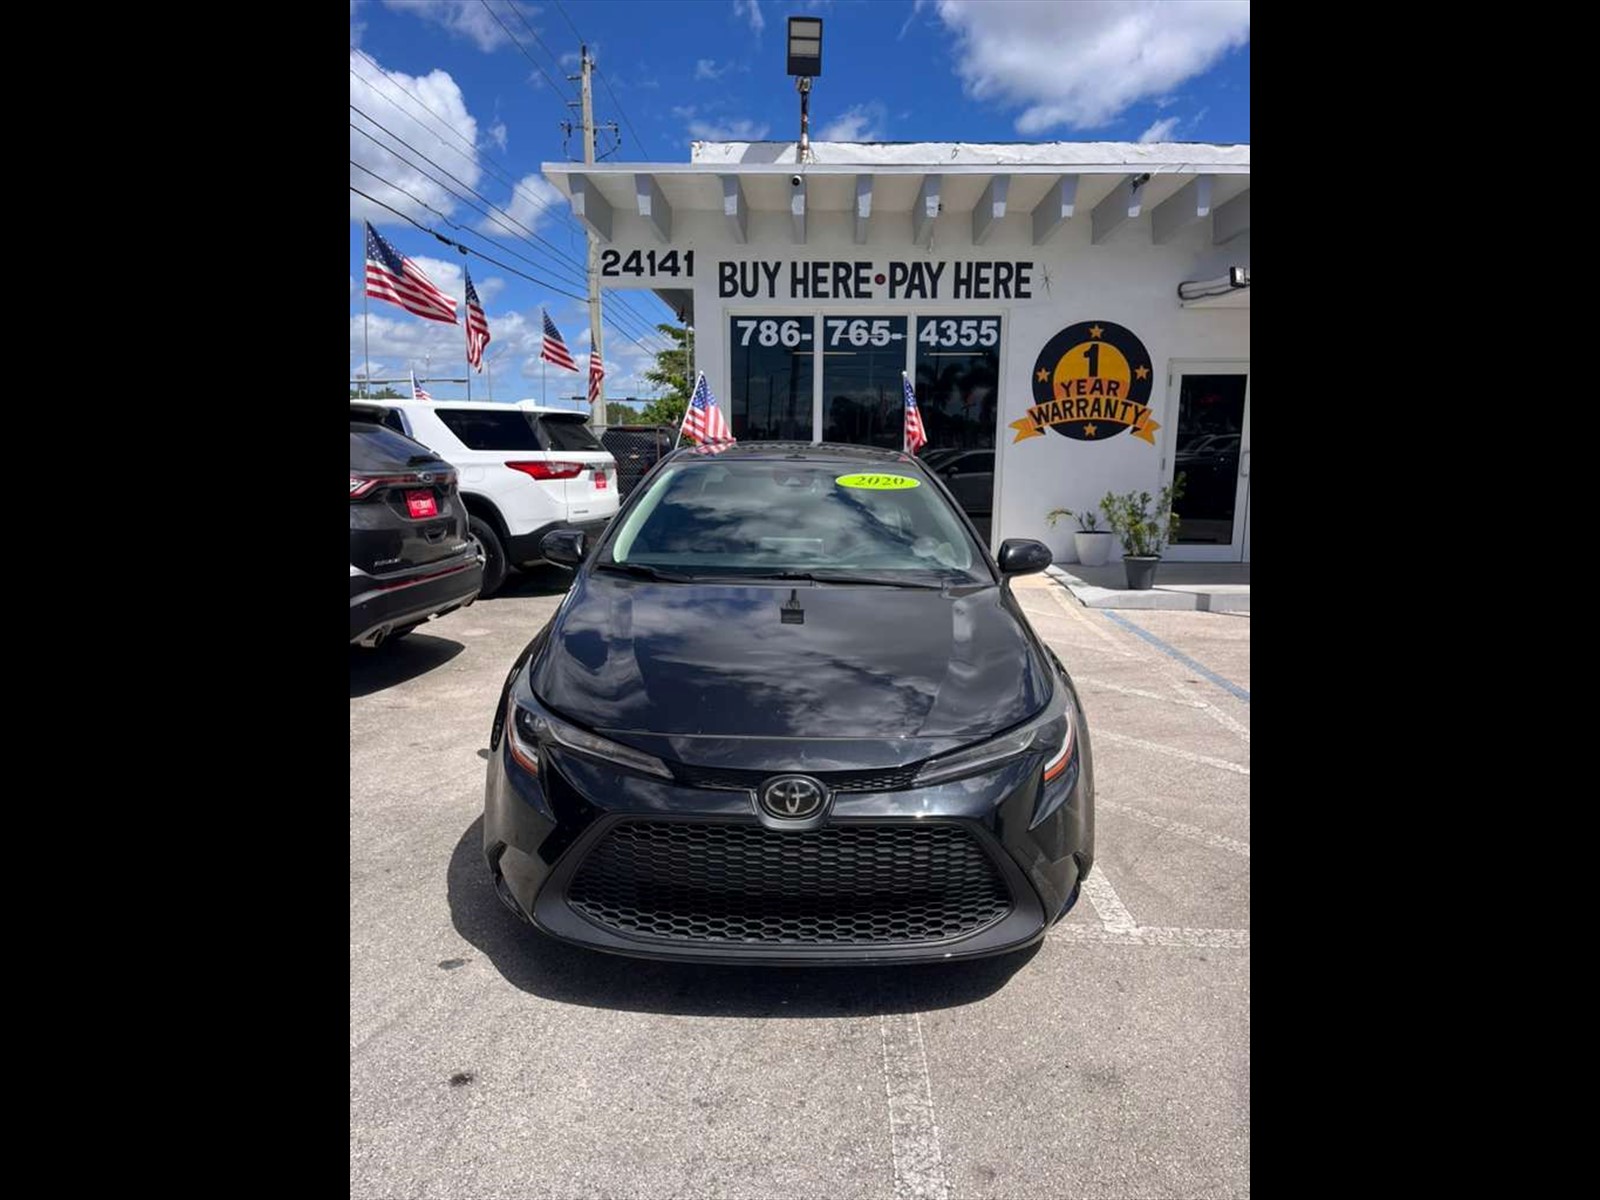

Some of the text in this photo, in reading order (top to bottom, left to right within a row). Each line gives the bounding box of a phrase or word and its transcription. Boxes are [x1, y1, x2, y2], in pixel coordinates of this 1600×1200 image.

[601, 249, 694, 277] 24141
[718, 261, 1034, 299] BUY HERE PAY HERE
[736, 319, 998, 347] 786- 765- 4355
[1083, 343, 1099, 377] 1
[1061, 378, 1120, 397] YEAR
[1028, 397, 1148, 426] WARRANTY
[855, 476, 905, 486] 2020
